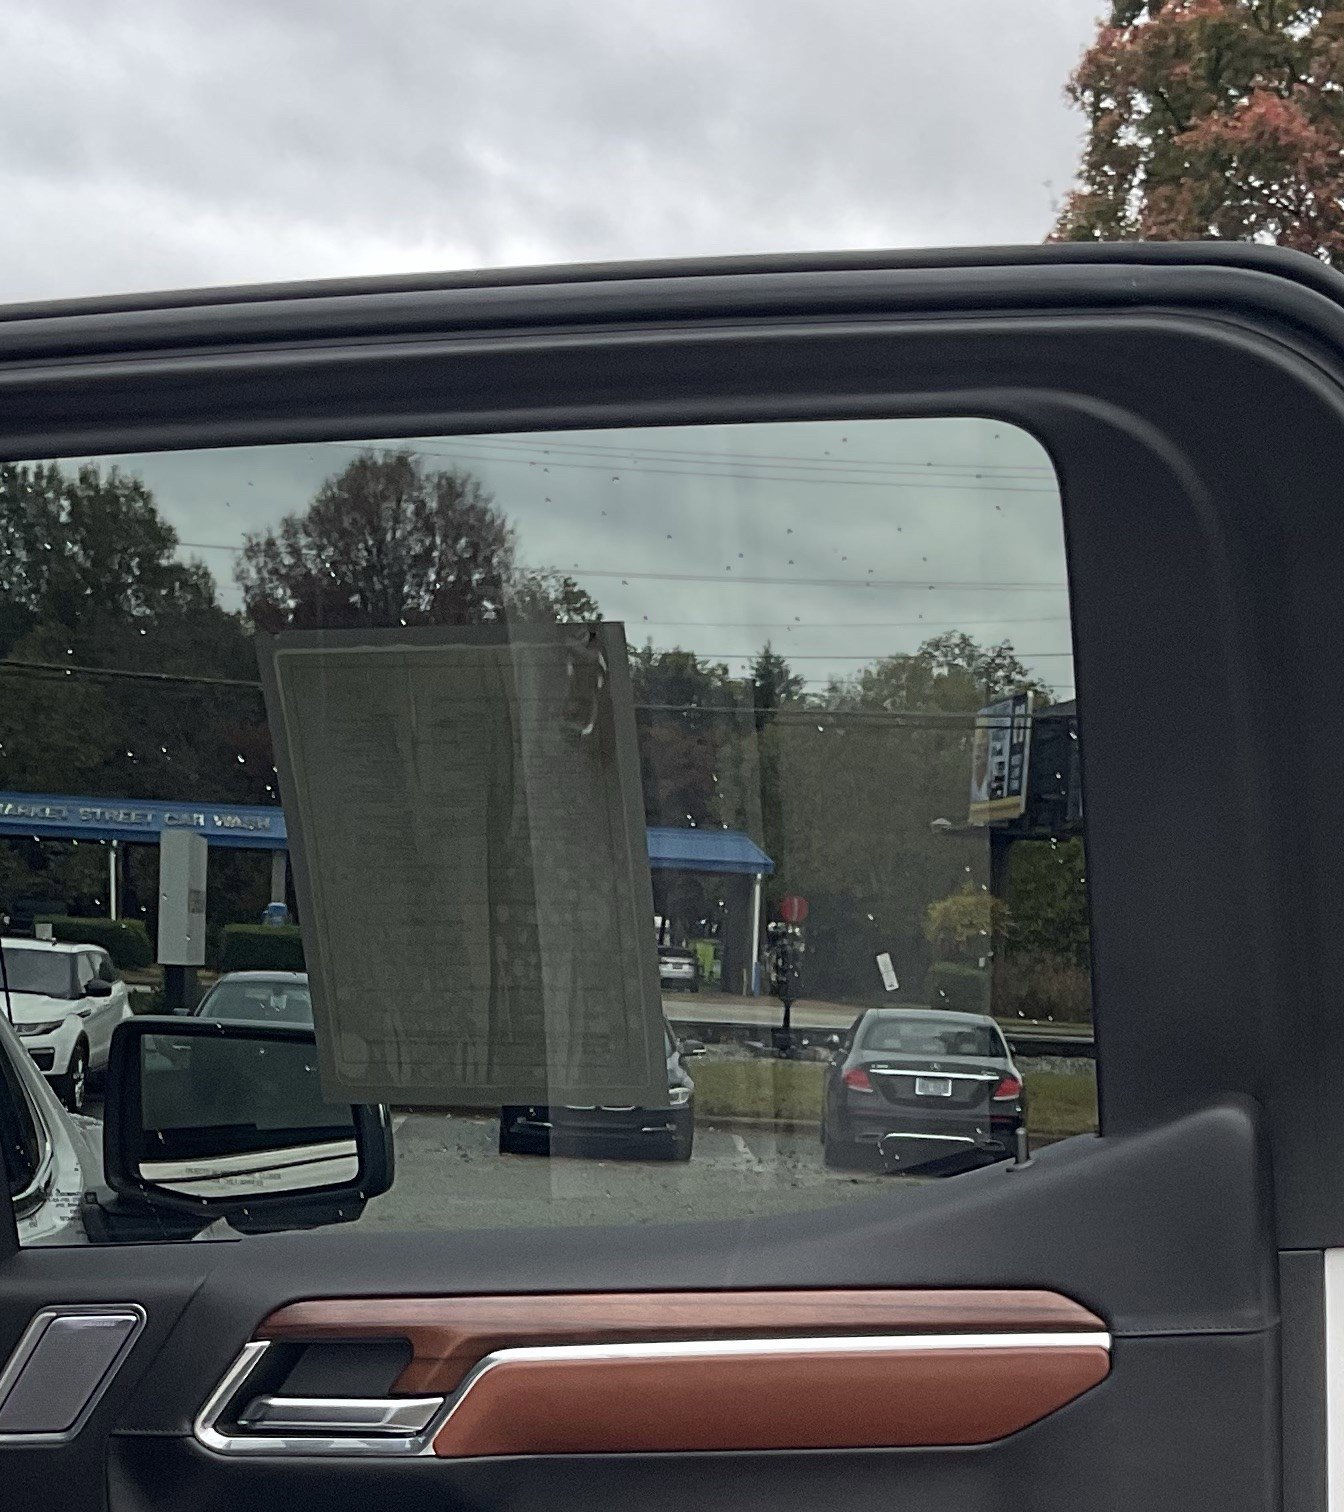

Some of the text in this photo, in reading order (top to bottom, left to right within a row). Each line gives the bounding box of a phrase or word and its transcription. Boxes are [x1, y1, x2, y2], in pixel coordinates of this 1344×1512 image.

[79, 807, 153, 826] STREET
[165, 813, 205, 827] CAR
[213, 815, 271, 830] WASH
